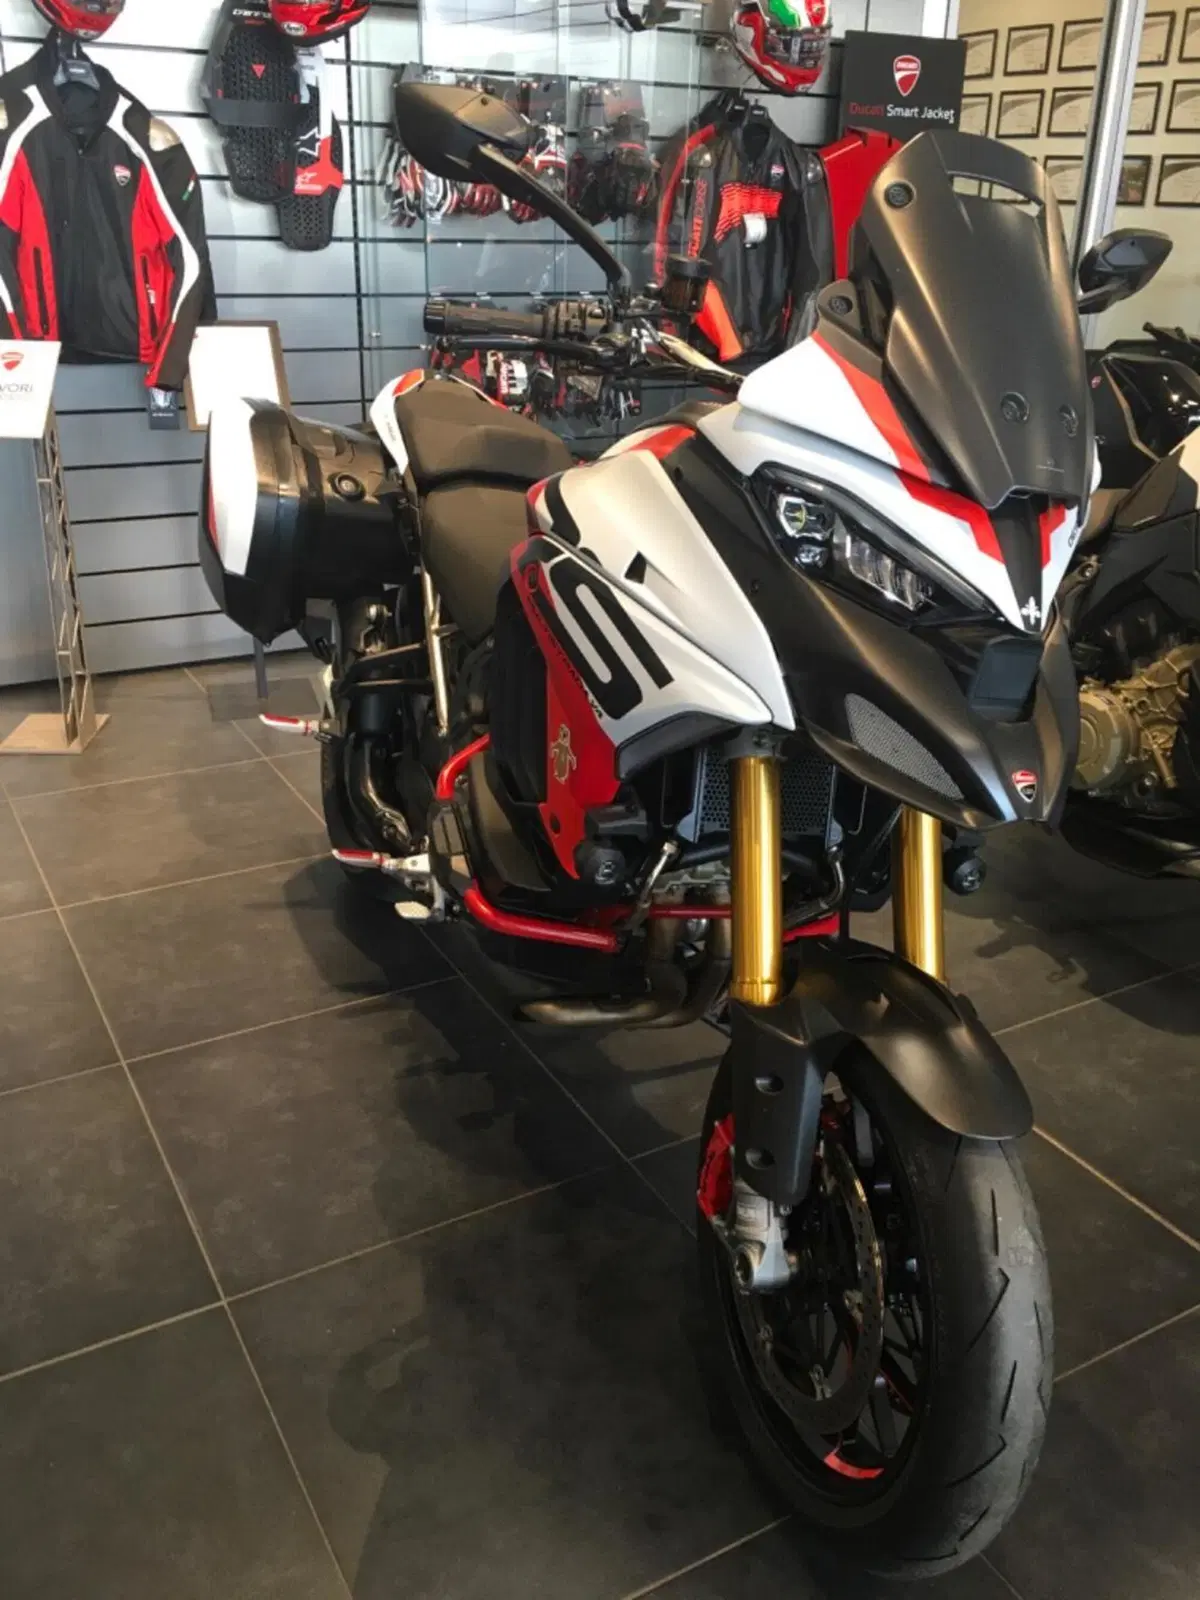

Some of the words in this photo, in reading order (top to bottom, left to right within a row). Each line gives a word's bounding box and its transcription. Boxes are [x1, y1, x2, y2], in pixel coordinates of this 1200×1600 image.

[849, 102, 884, 116] Ducati
[886, 104, 919, 117] Smart
[921, 107, 954, 121] Jacket
